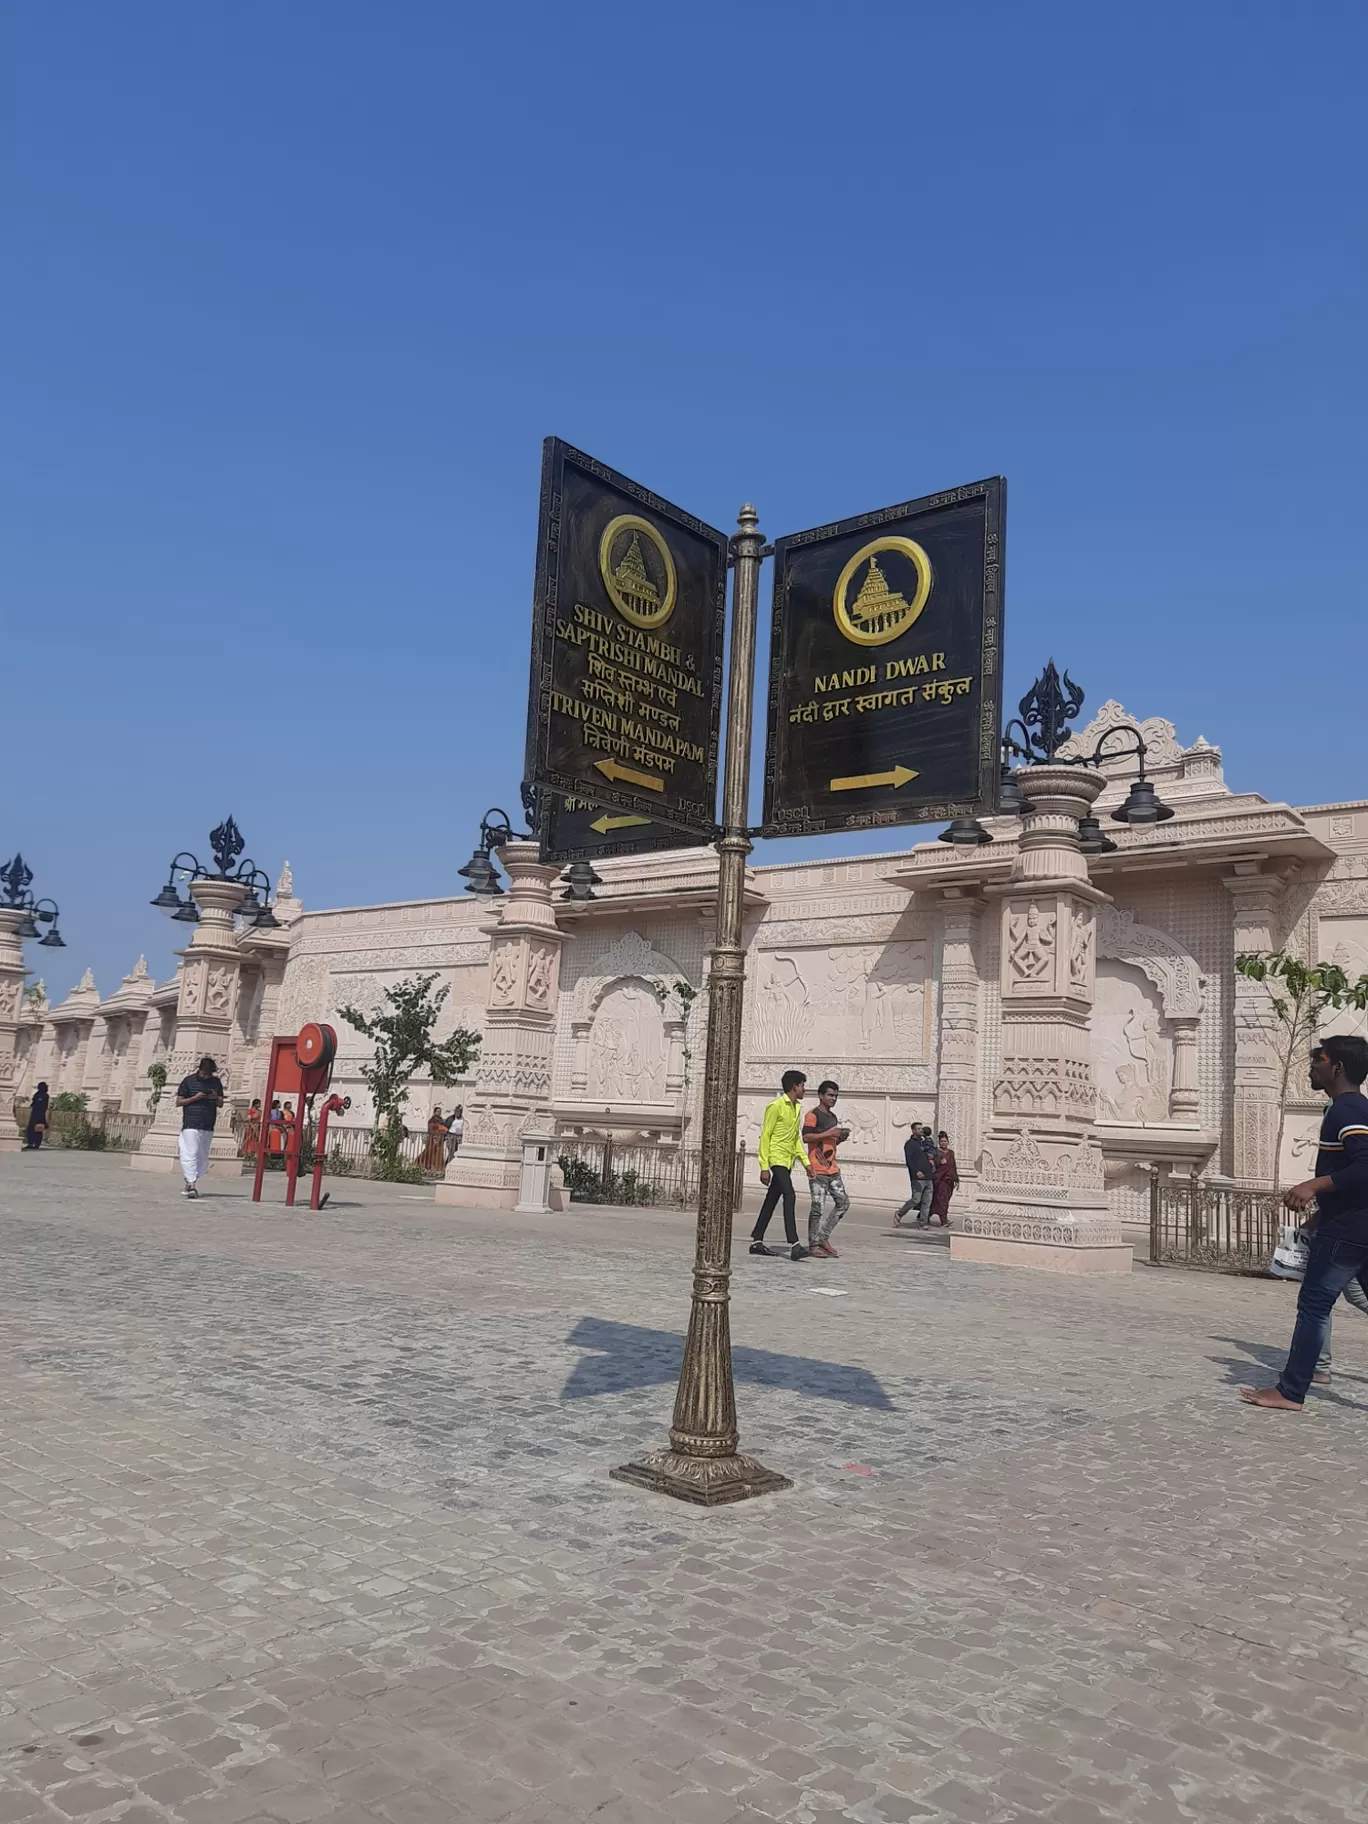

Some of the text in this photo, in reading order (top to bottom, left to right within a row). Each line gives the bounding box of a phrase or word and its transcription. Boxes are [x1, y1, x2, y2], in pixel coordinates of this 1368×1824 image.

[556, 618, 704, 697] SAPTRISHI MANDAL
[574, 604, 696, 673] SHIV STAMBH &
[588, 652, 678, 708] शिव स्तम्भ एवं
[789, 675, 973, 724] नंदी द्वार स्वागत संकुल
[814, 652, 946, 693] NANDI DWAR
[551, 691, 705, 764] TRIVENI MANDAPAM
[638, 701, 682, 732] मण्डल
[583, 722, 676, 775] त्रिवेणी मंडपम
